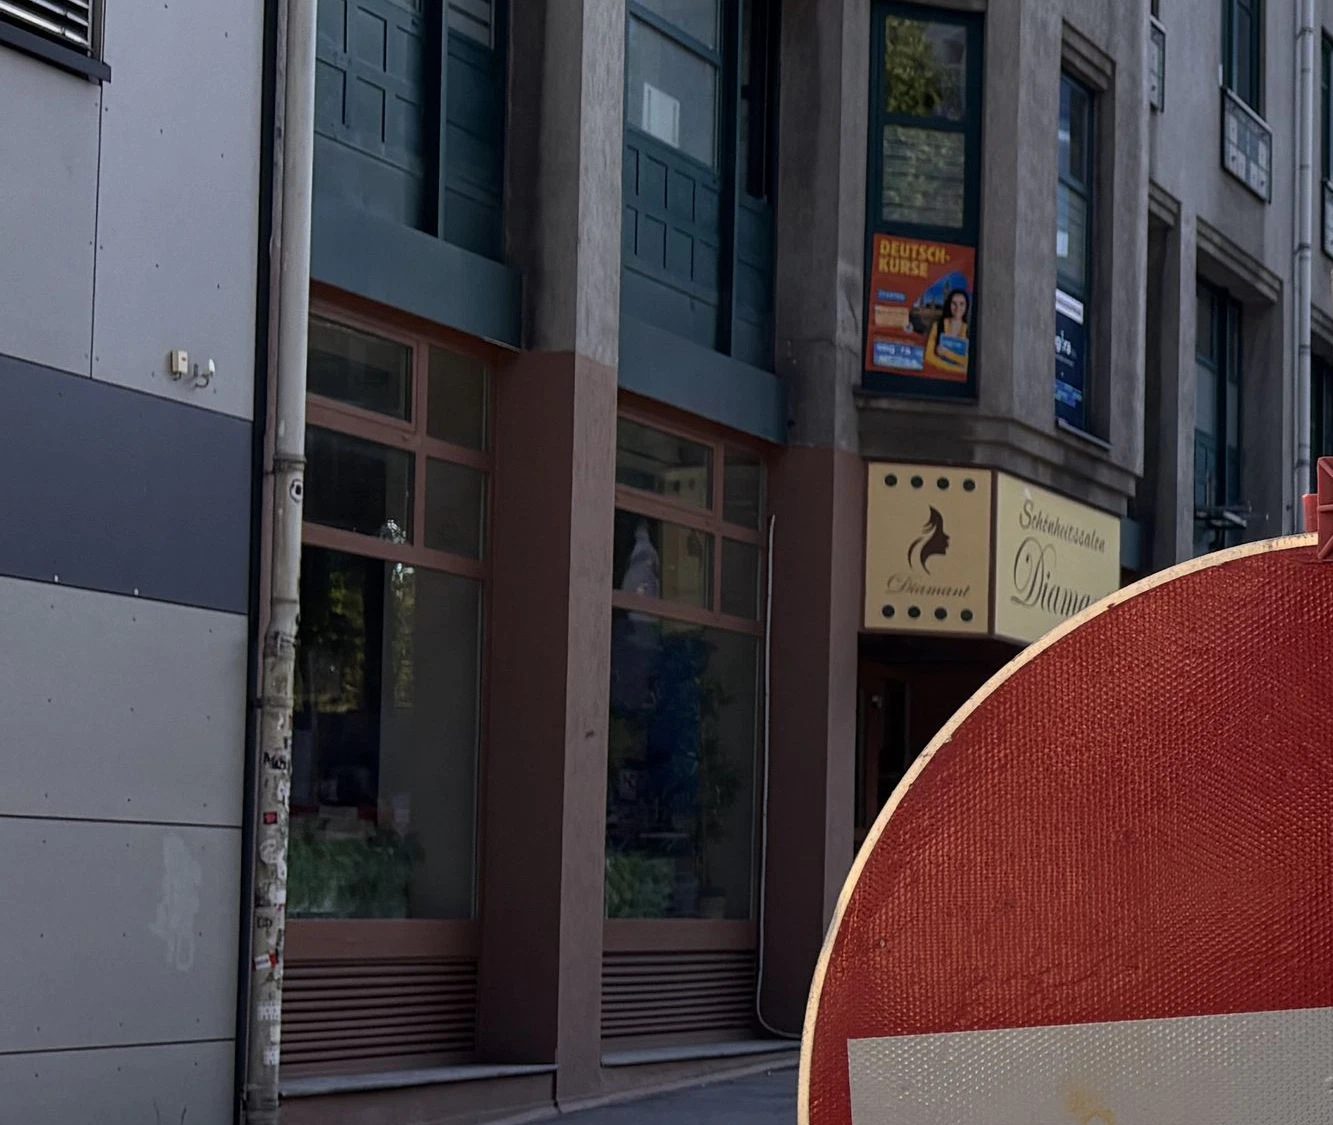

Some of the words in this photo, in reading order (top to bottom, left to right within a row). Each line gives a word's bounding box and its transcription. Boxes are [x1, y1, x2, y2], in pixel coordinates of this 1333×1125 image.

[879, 238, 951, 264] DEUTSCH-
[878, 256, 928, 278] KURSE
[885, 573, 970, 598] Diamant
